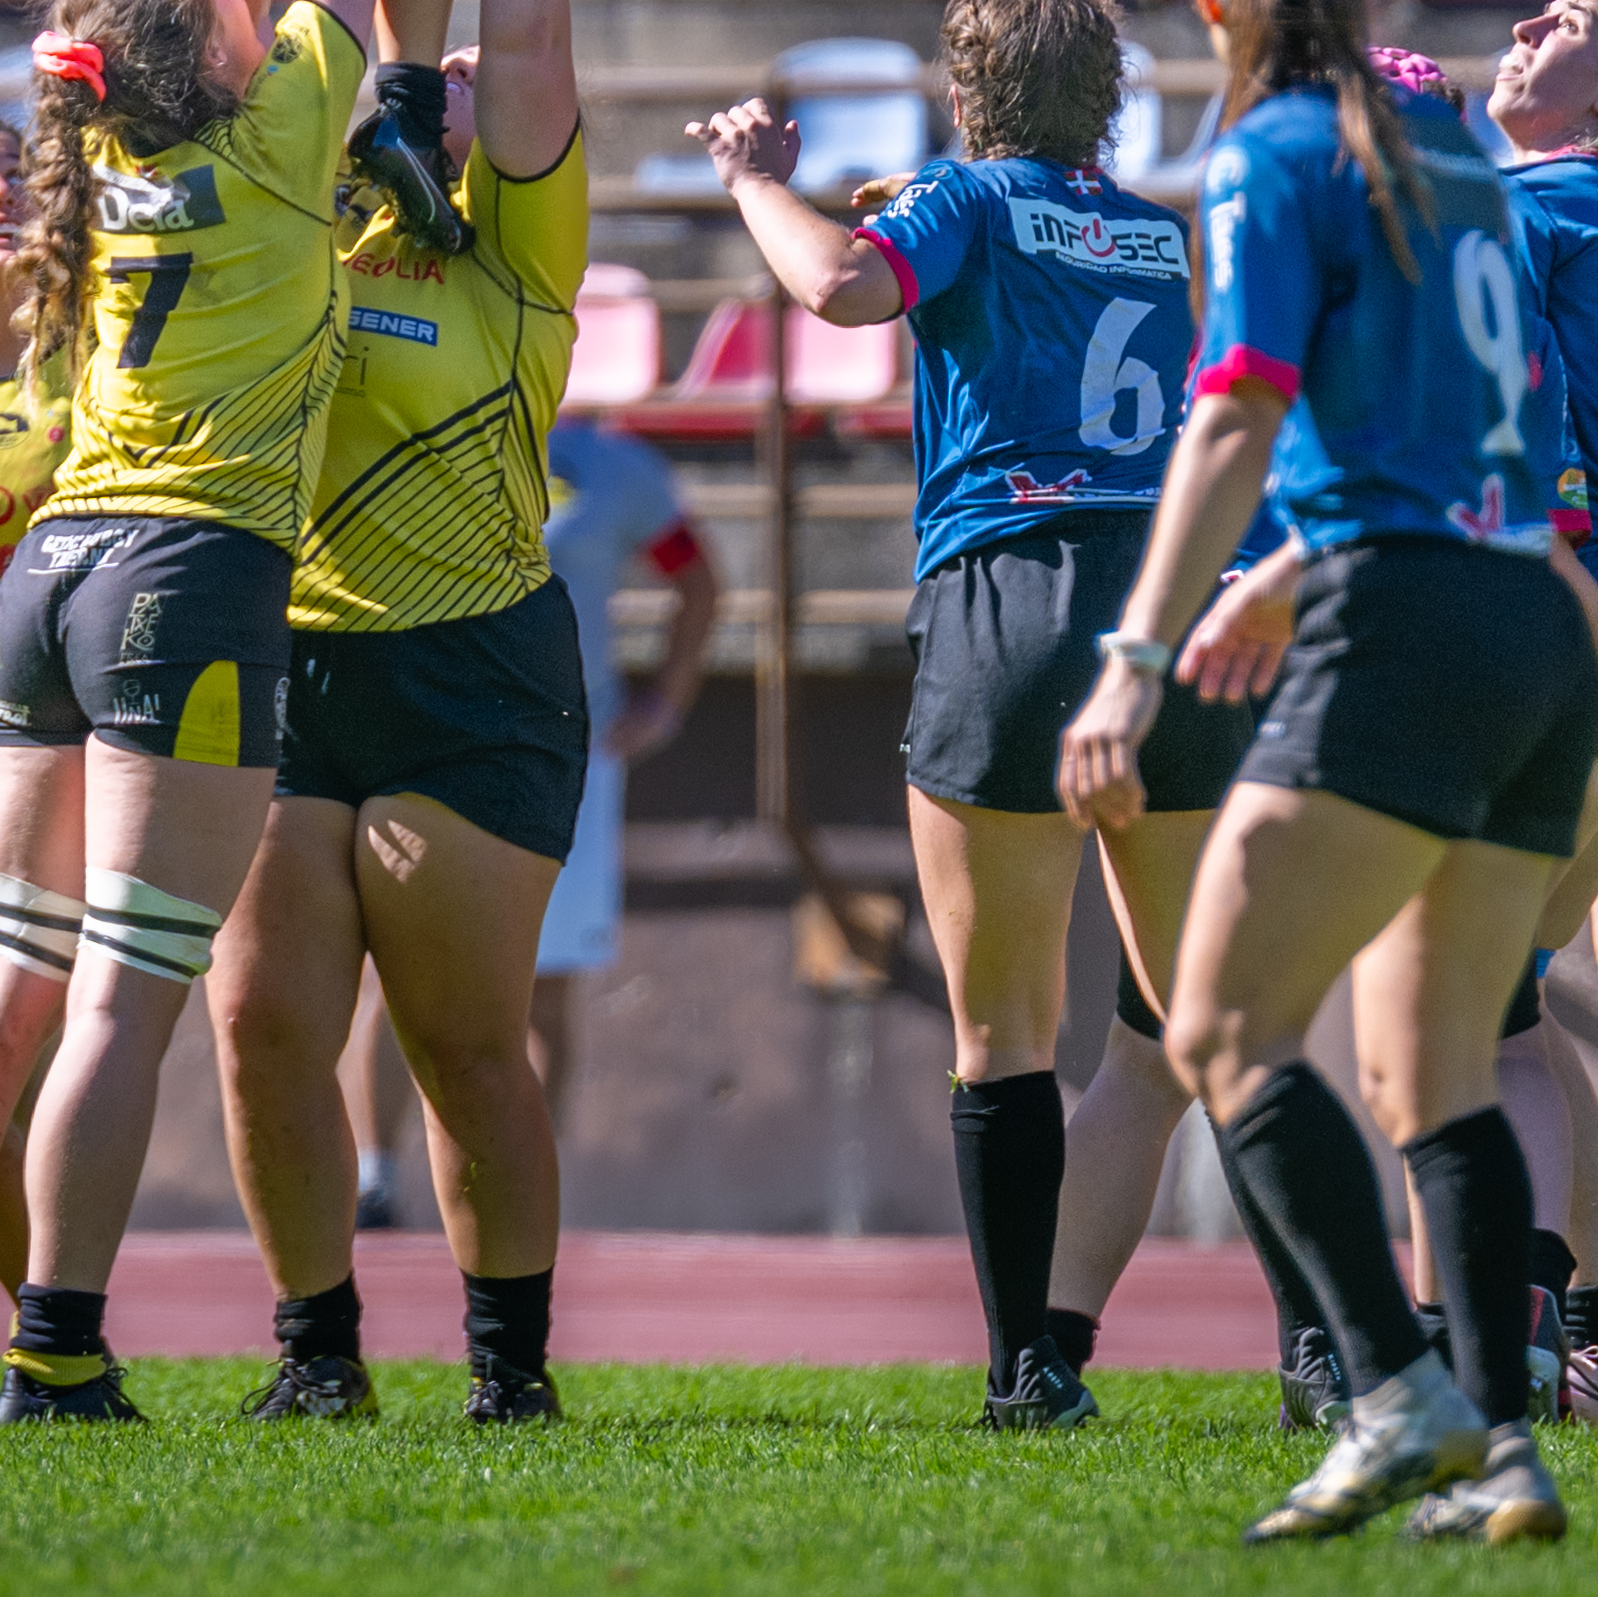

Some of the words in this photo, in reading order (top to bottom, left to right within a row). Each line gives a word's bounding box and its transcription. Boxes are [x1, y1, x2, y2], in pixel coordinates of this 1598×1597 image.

[105, 252, 193, 369] 7
[344, 252, 445, 285] EOLIA
[1079, 297, 1166, 456] 6
[1455, 230, 1525, 454] 9
